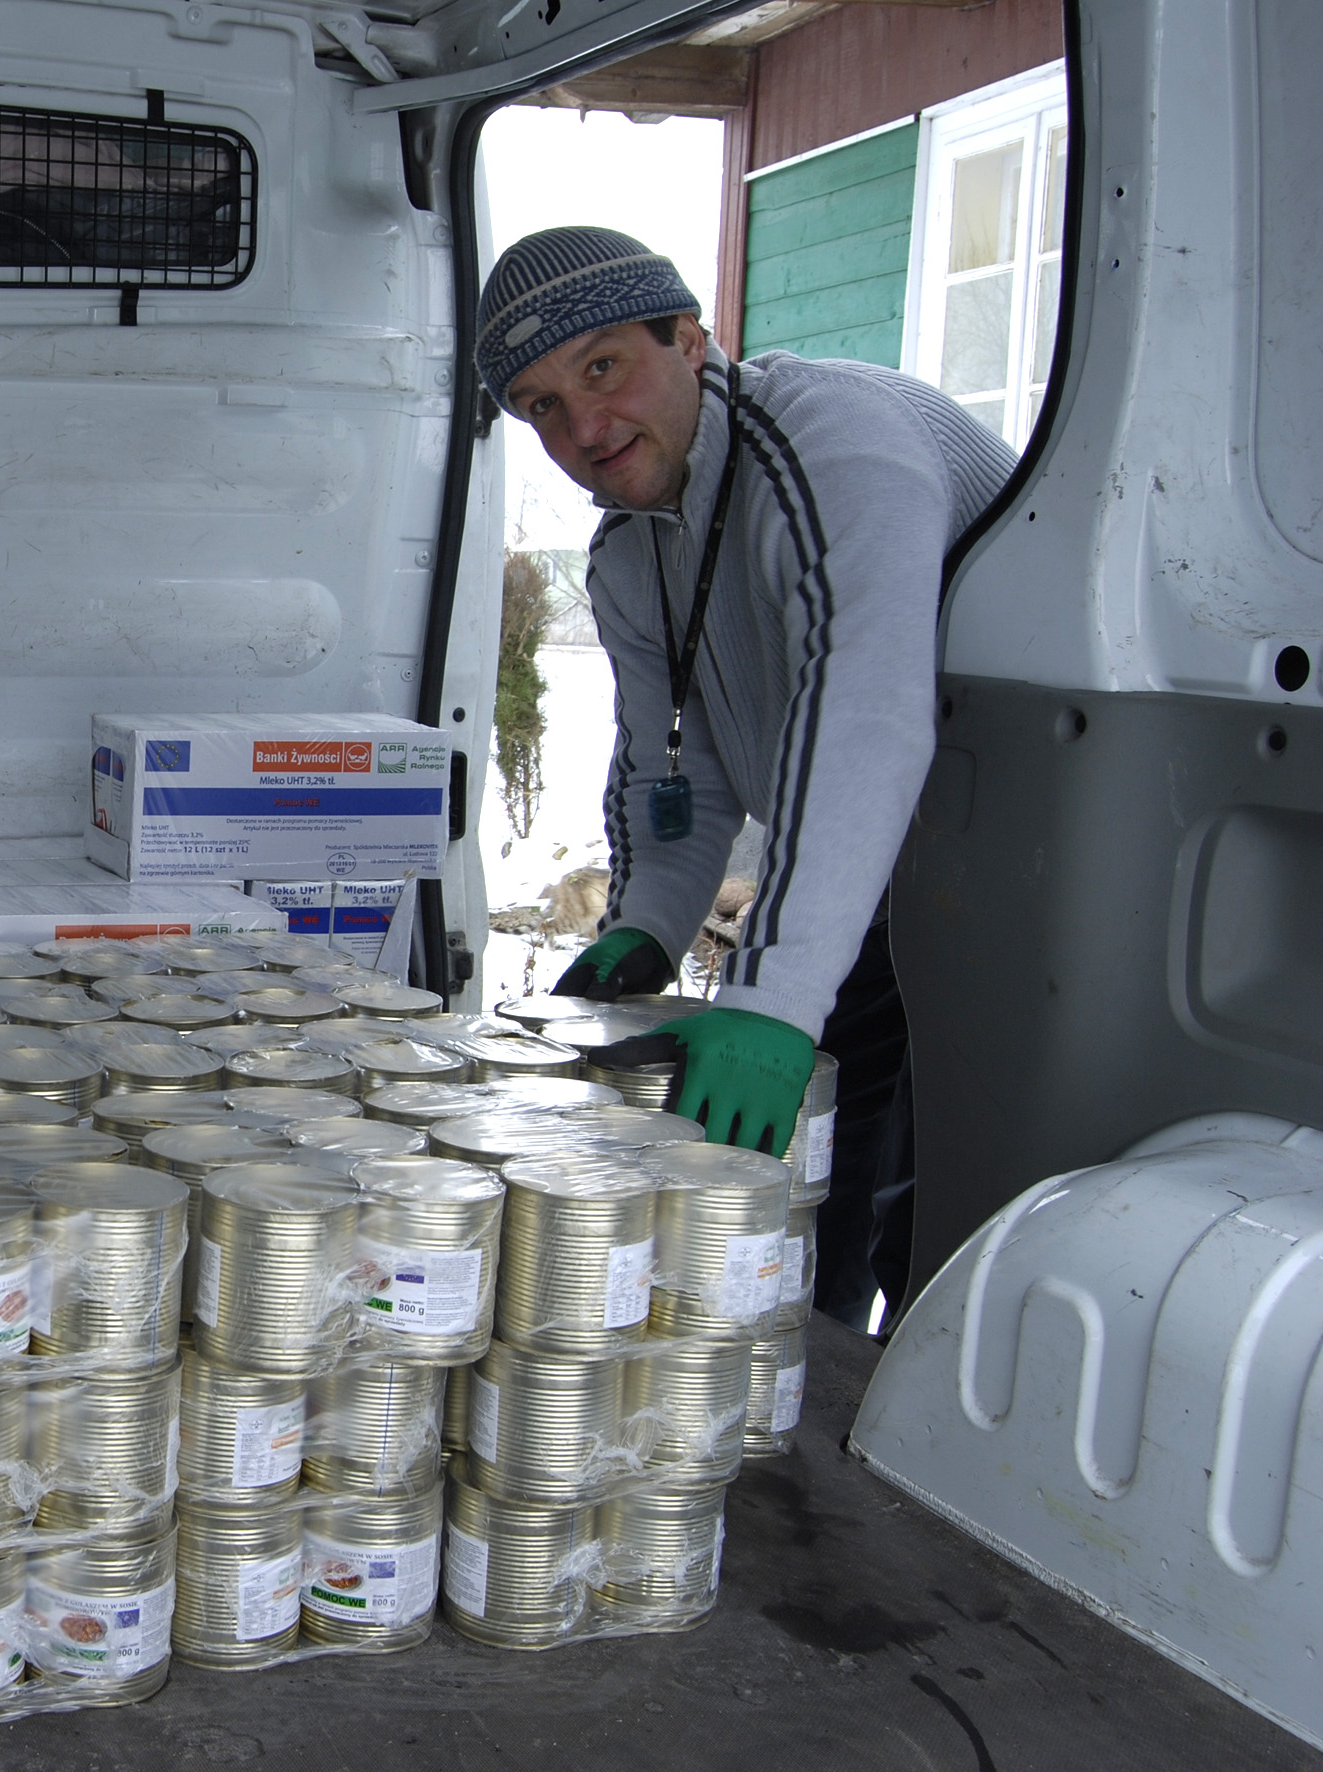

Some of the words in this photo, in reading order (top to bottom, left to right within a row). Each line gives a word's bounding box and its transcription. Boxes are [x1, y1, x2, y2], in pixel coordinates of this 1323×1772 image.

[256, 751, 288, 763] Banki
[291, 748, 340, 765] Żywności
[259, 776, 285, 785] Mleko
[287, 776, 305, 785] UHT
[306, 777, 326, 786] 3,2%
[328, 776, 336, 785] tł.
[305, 798, 319, 806] WE
[201, 846, 213, 854] (12
[299, 886, 324, 895] UHT
[343, 886, 376, 895] Mleko
[380, 885, 404, 894] UHT
[271, 896, 298, 905] 3,2%
[302, 896, 313, 905] tł.
[352, 895, 378, 905] 3,2%
[382, 895, 392, 904] tł.
[303, 916, 320, 924] WE
[201, 926, 229, 935] ARR
[377, 1300, 393, 1311] WE
[398, 1303, 415, 1313] 800
[418, 1307, 425, 1316] g
[311, 1586, 345, 1604] POMOC
[348, 1598, 366, 1608] WE
[134, 1648, 140, 1657] g
